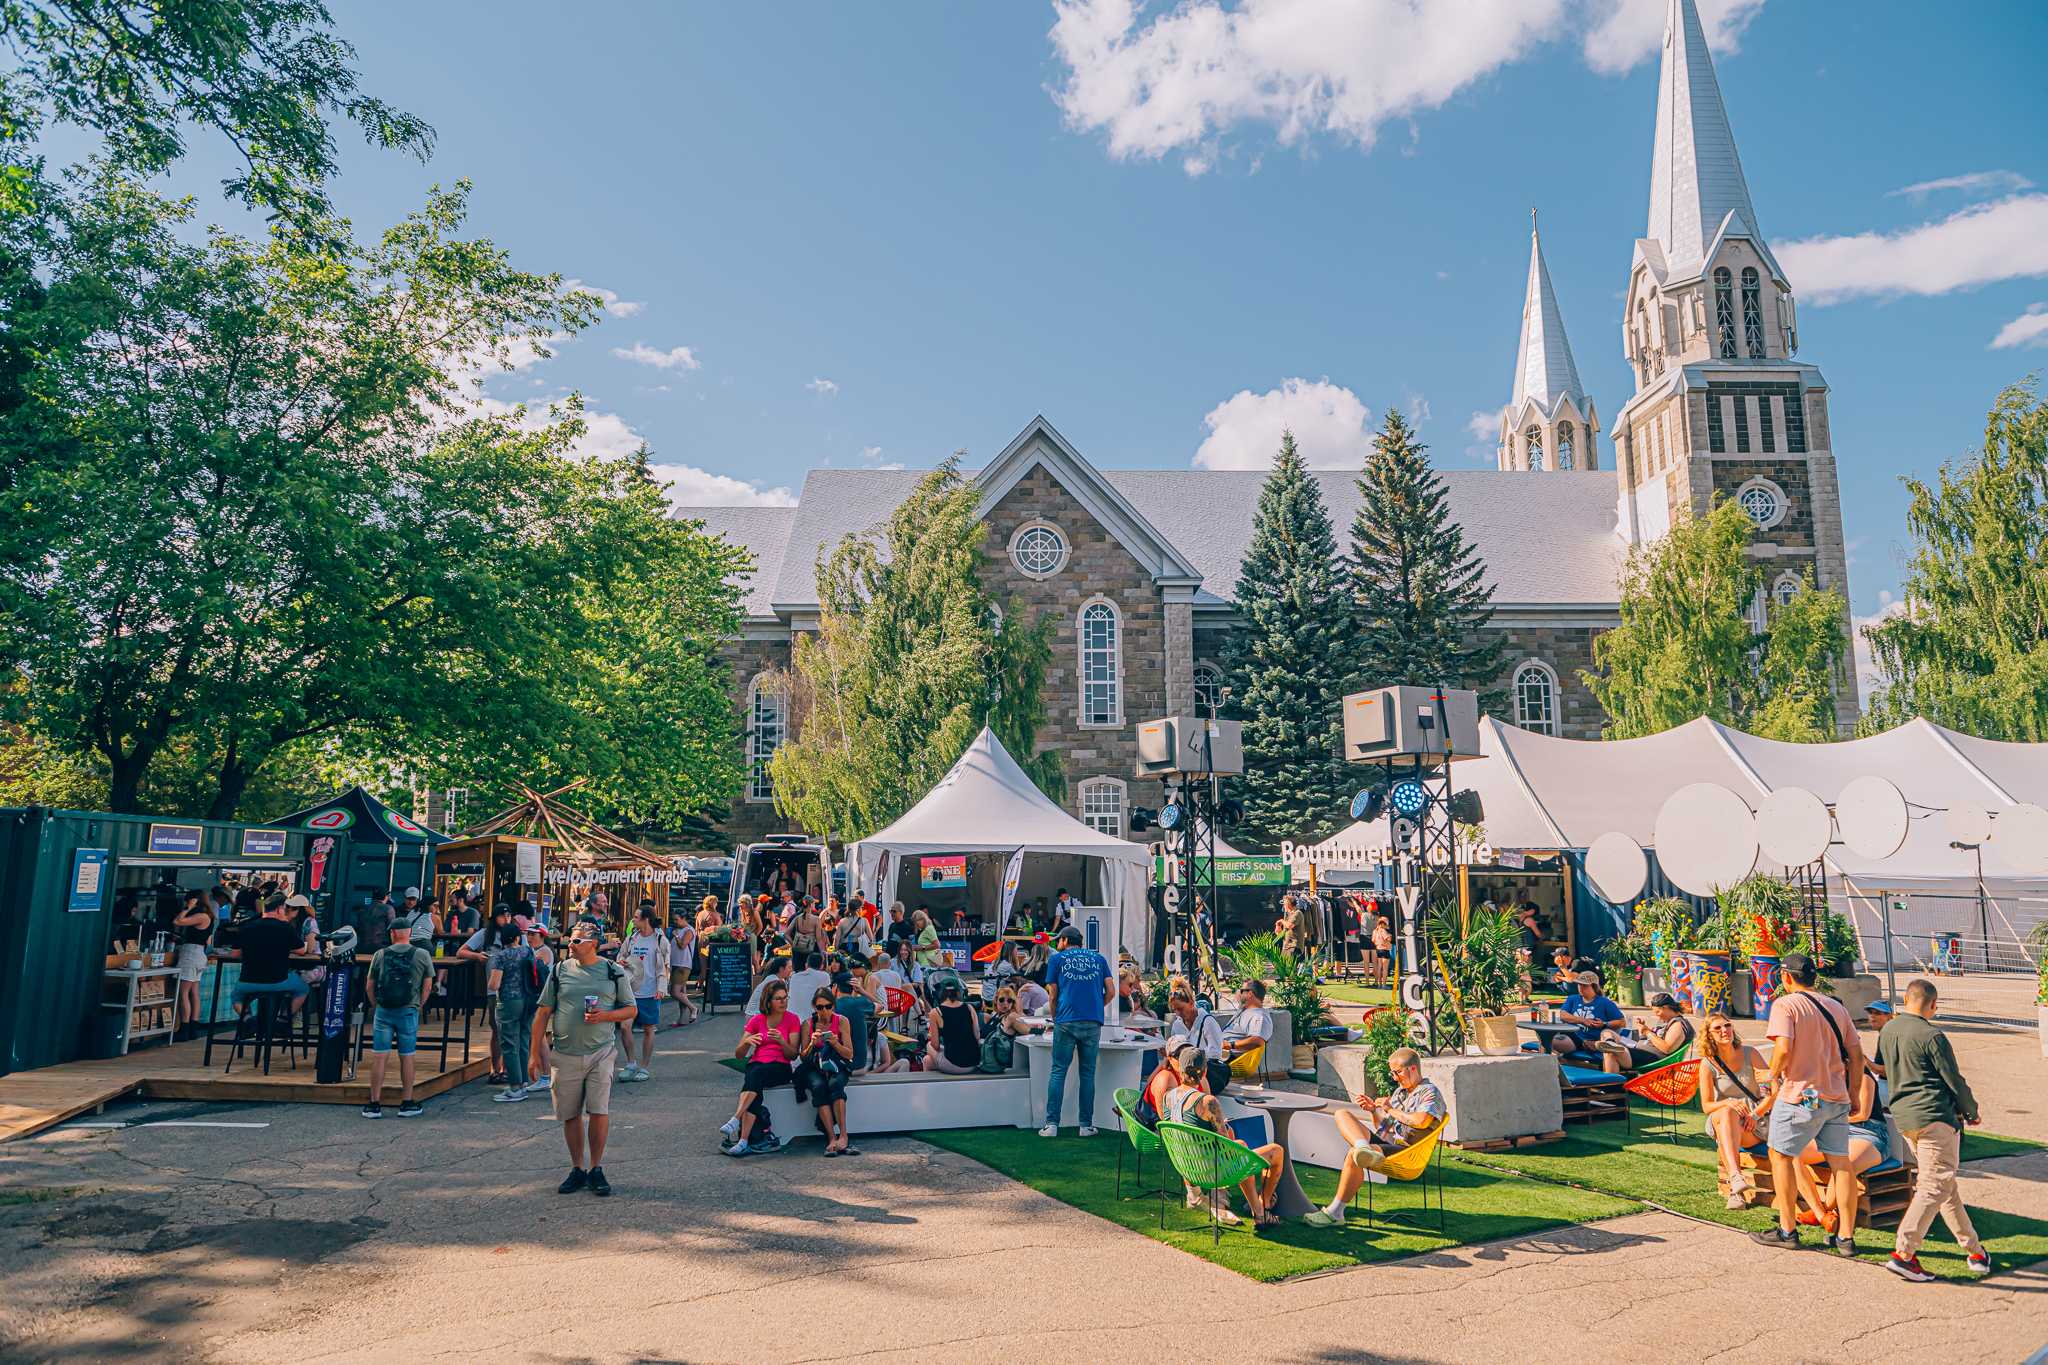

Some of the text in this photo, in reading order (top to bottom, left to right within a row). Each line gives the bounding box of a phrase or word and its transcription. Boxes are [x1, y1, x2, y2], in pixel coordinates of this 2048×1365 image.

[1254, 862, 1282, 871] SOINS
[543, 864, 641, 887] éveloppement
[643, 864, 689, 884] Durable
[1222, 872, 1266, 881] FIRST AID
[1392, 814, 1430, 1047] ervice
[1064, 956, 1096, 964] BANKS
[1061, 961, 1101, 973] JOURNAL
